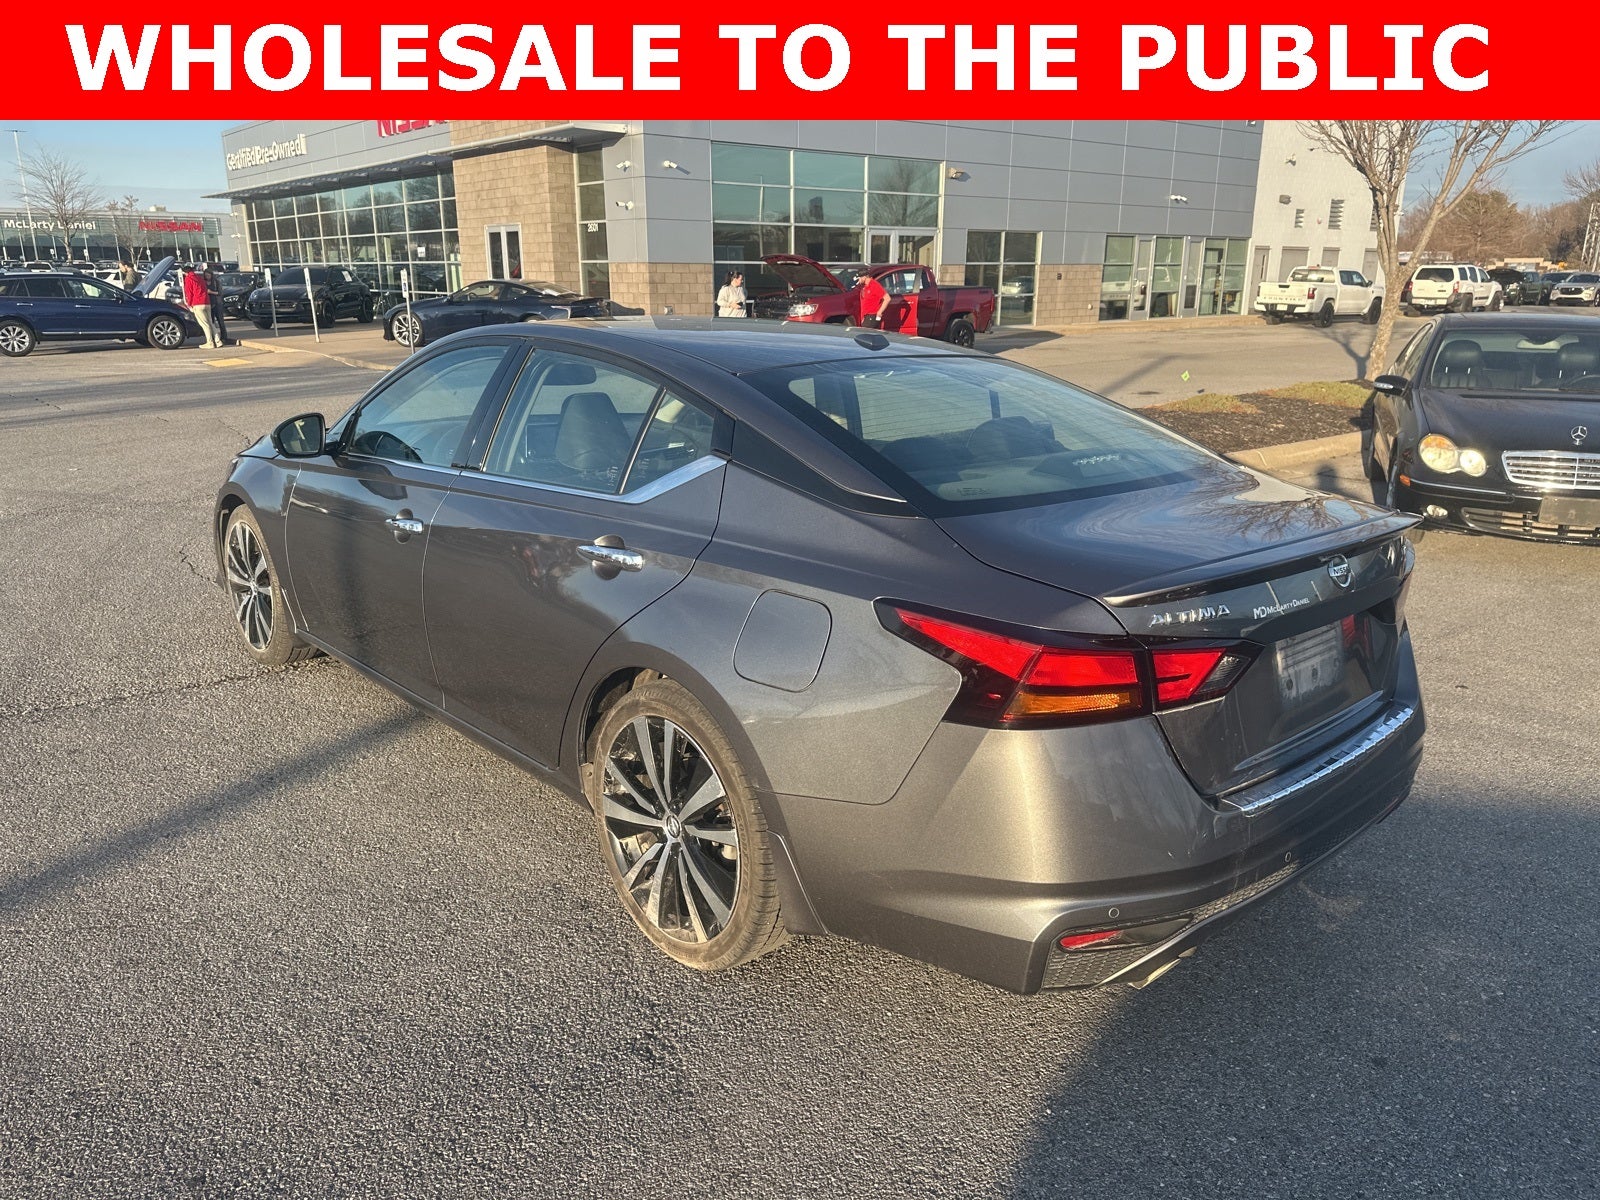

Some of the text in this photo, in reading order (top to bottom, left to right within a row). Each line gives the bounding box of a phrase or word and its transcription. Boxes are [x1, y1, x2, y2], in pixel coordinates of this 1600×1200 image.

[255, 133, 307, 165] Pre-Owned
[4, 219, 96, 232] McLarty Daniel
[138, 220, 202, 232] NISSAN
[1148, 604, 1231, 628] ALTIMA
